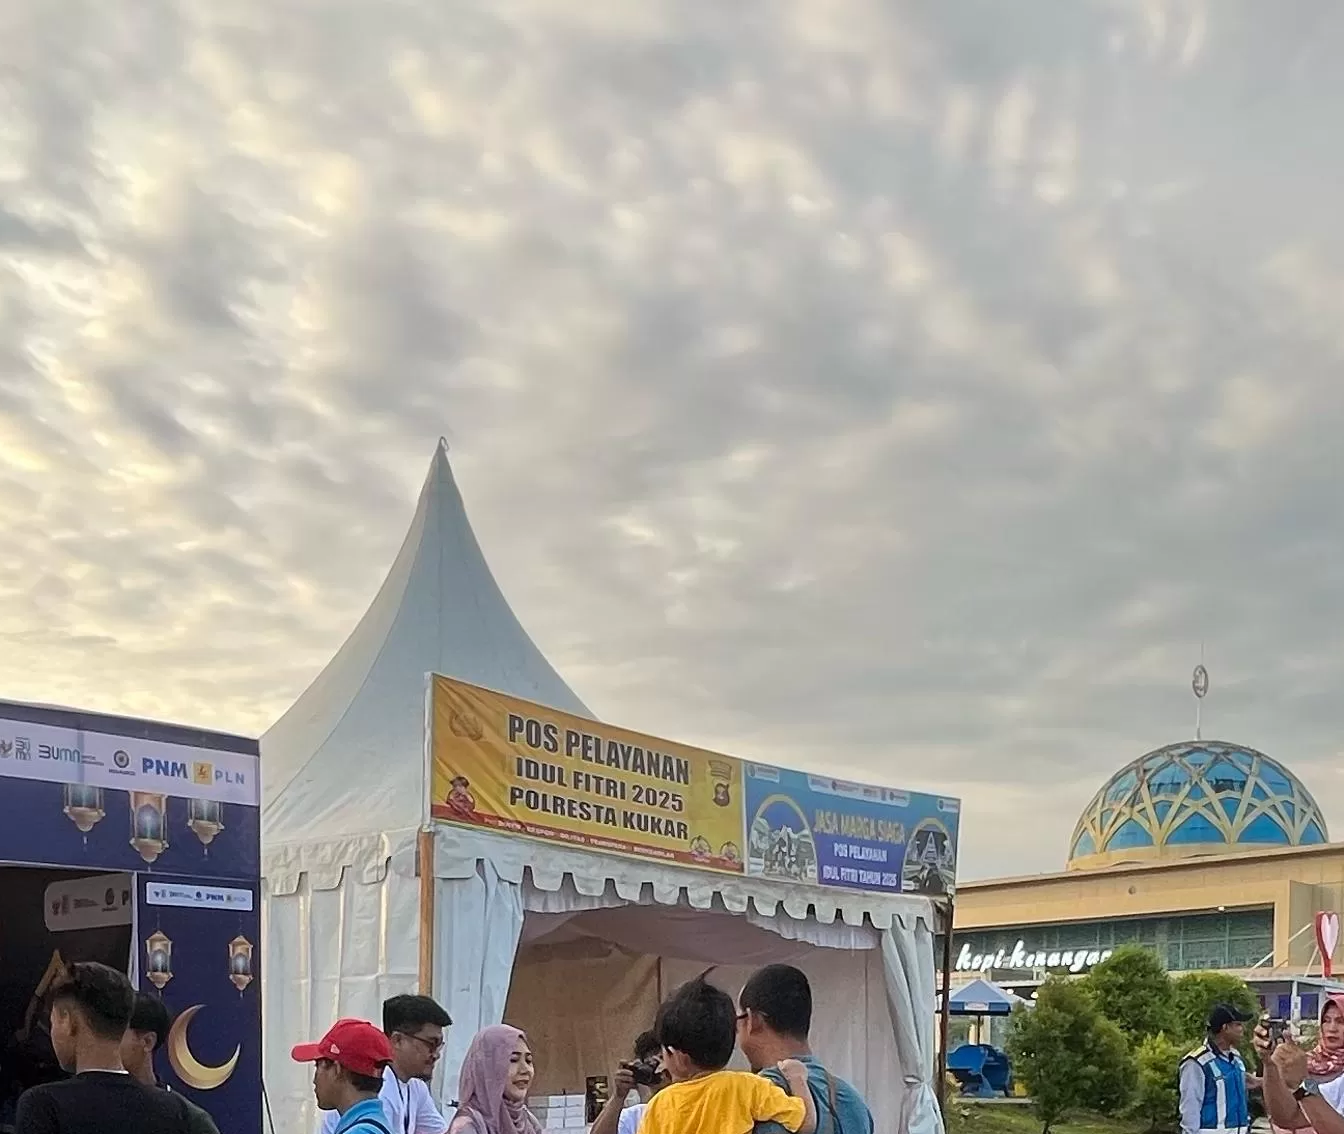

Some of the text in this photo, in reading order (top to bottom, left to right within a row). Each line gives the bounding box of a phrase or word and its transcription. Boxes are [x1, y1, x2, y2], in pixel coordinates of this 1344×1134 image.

[142, 757, 188, 779] PNM
[508, 714, 690, 786] POS PELAYANAN
[516, 757, 684, 812] IDUL FITRI 2025
[510, 786, 689, 841] POLRESTA KUKAR
[955, 943, 1005, 973] kopi
